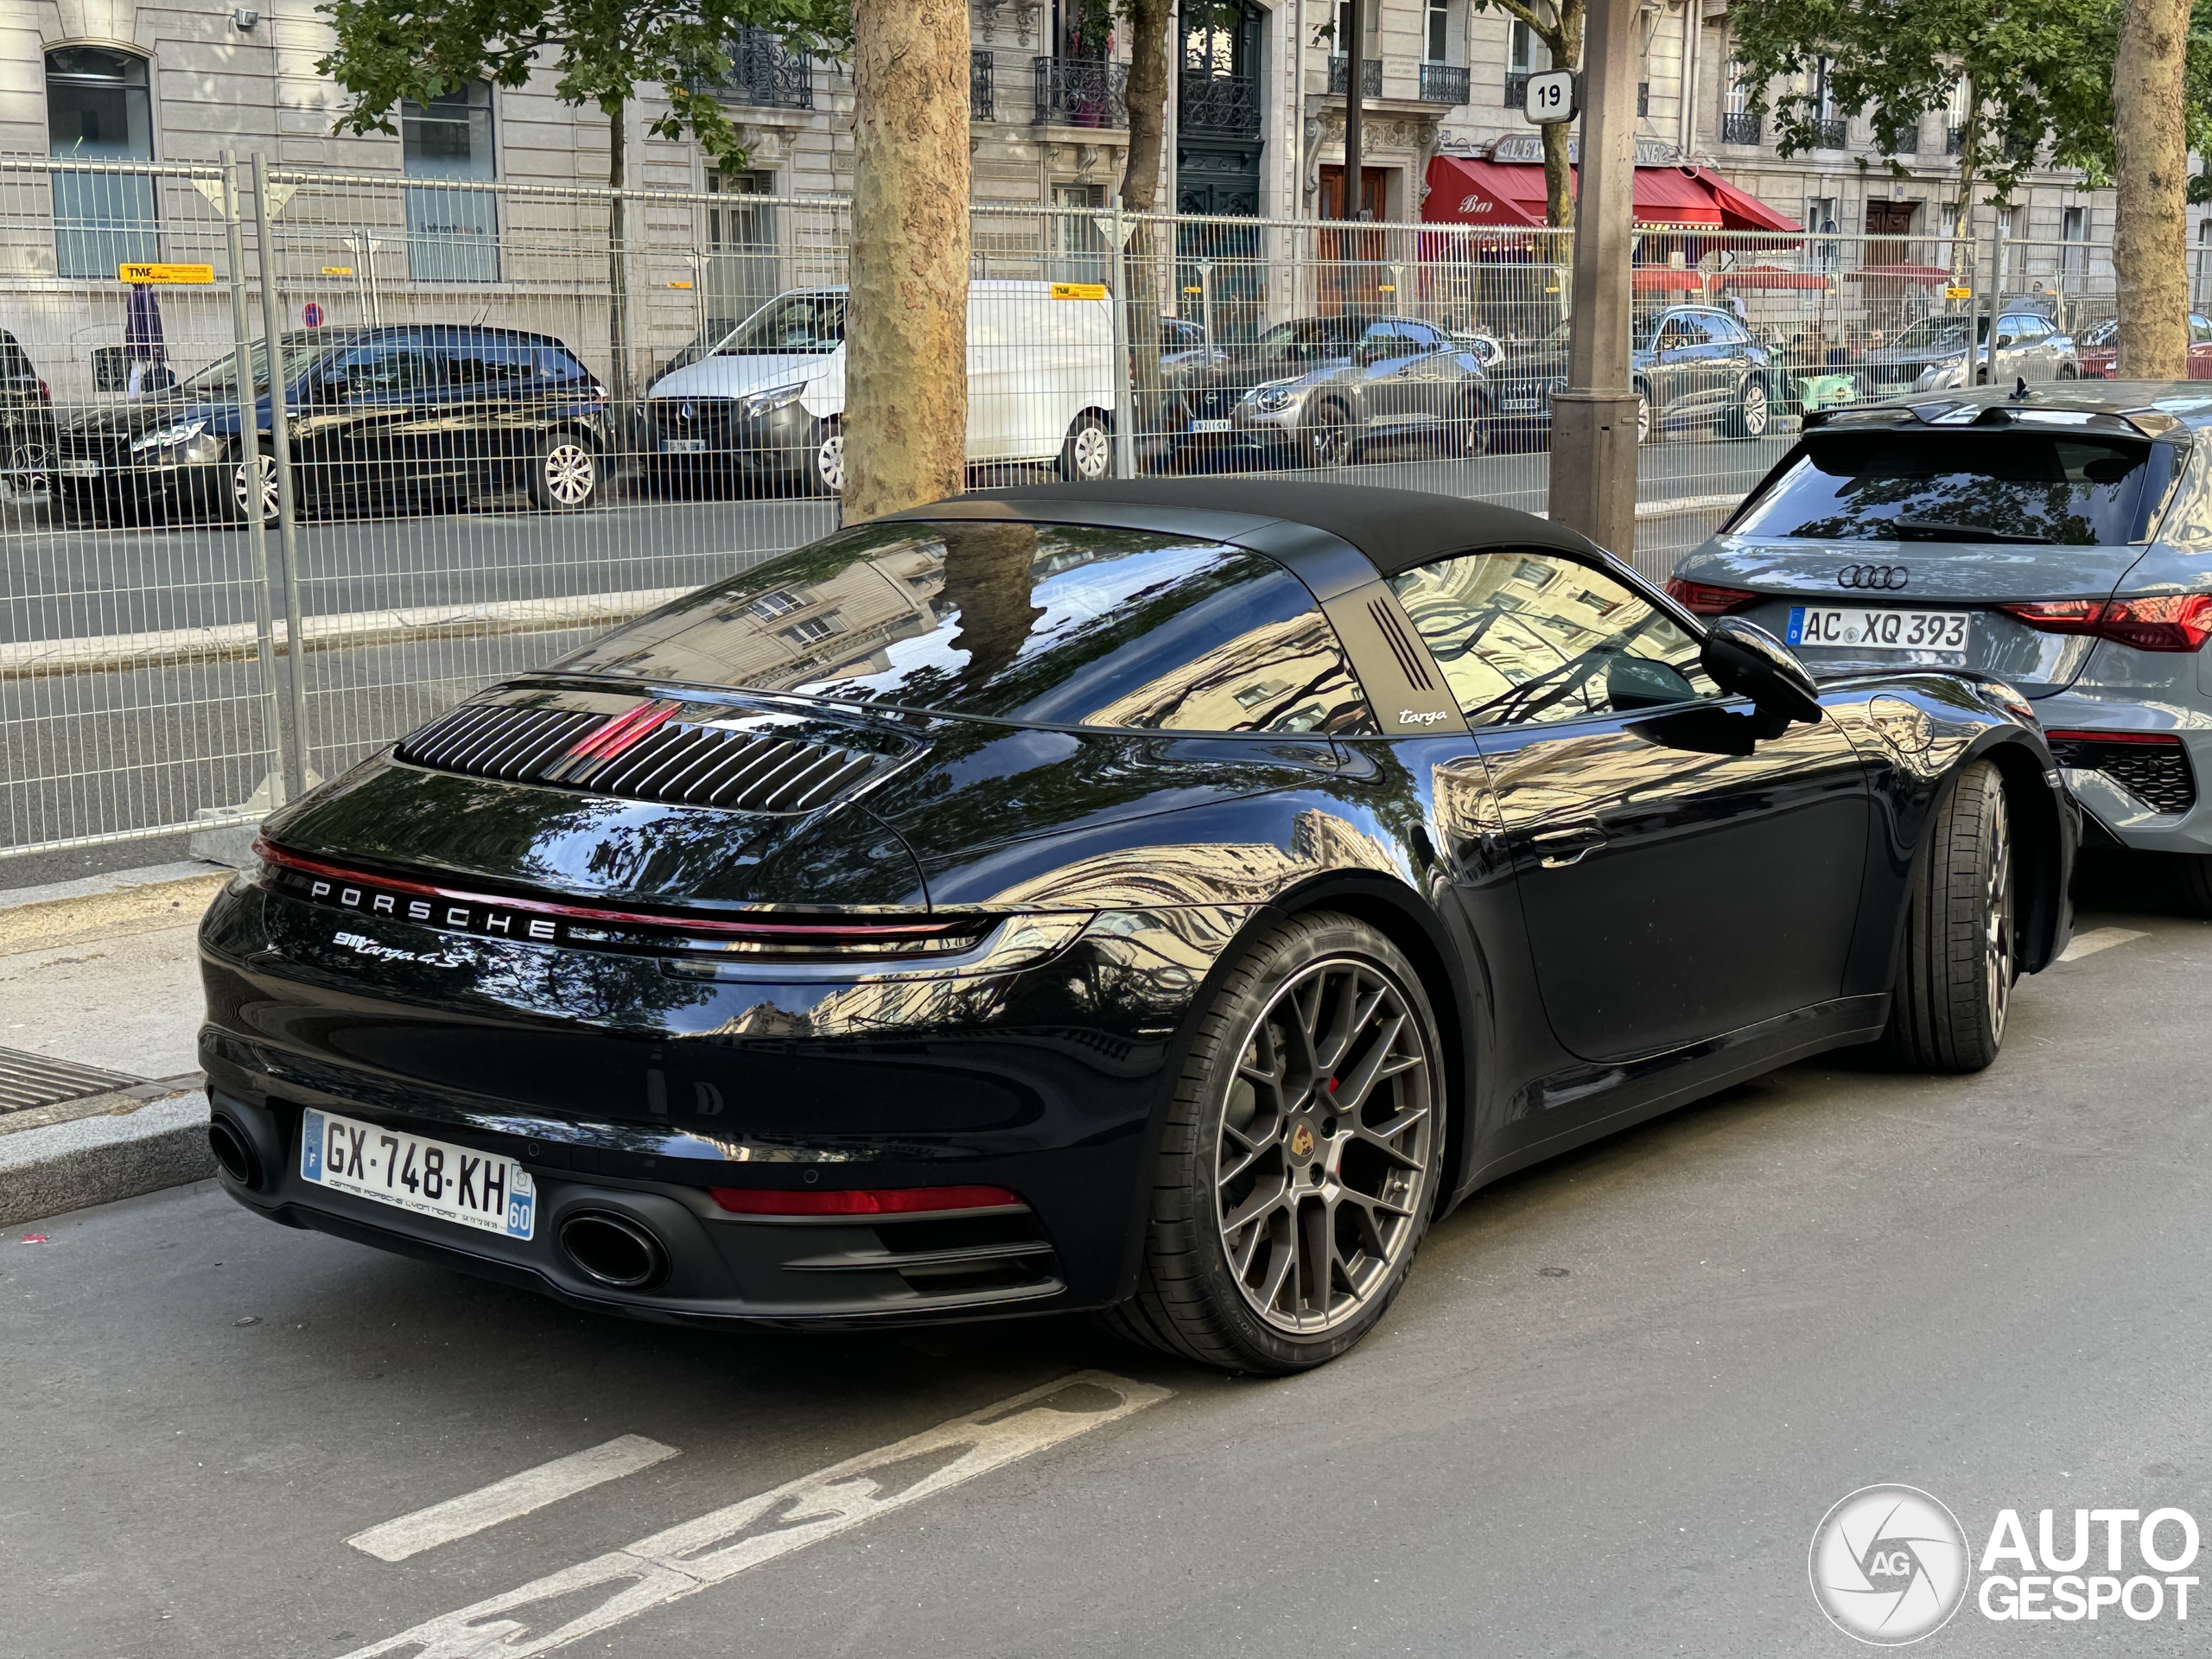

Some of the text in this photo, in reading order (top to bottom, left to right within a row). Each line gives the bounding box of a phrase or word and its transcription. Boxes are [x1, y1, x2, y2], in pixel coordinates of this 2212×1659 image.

[1538, 85, 1560, 108] 19
[1458, 194, 1494, 213] Bar
[1790, 629, 1798, 639] D
[1803, 612, 1966, 646] AC XQ 393
[311, 880, 556, 940] PORSCHE
[509, 1202, 531, 1230] 60
